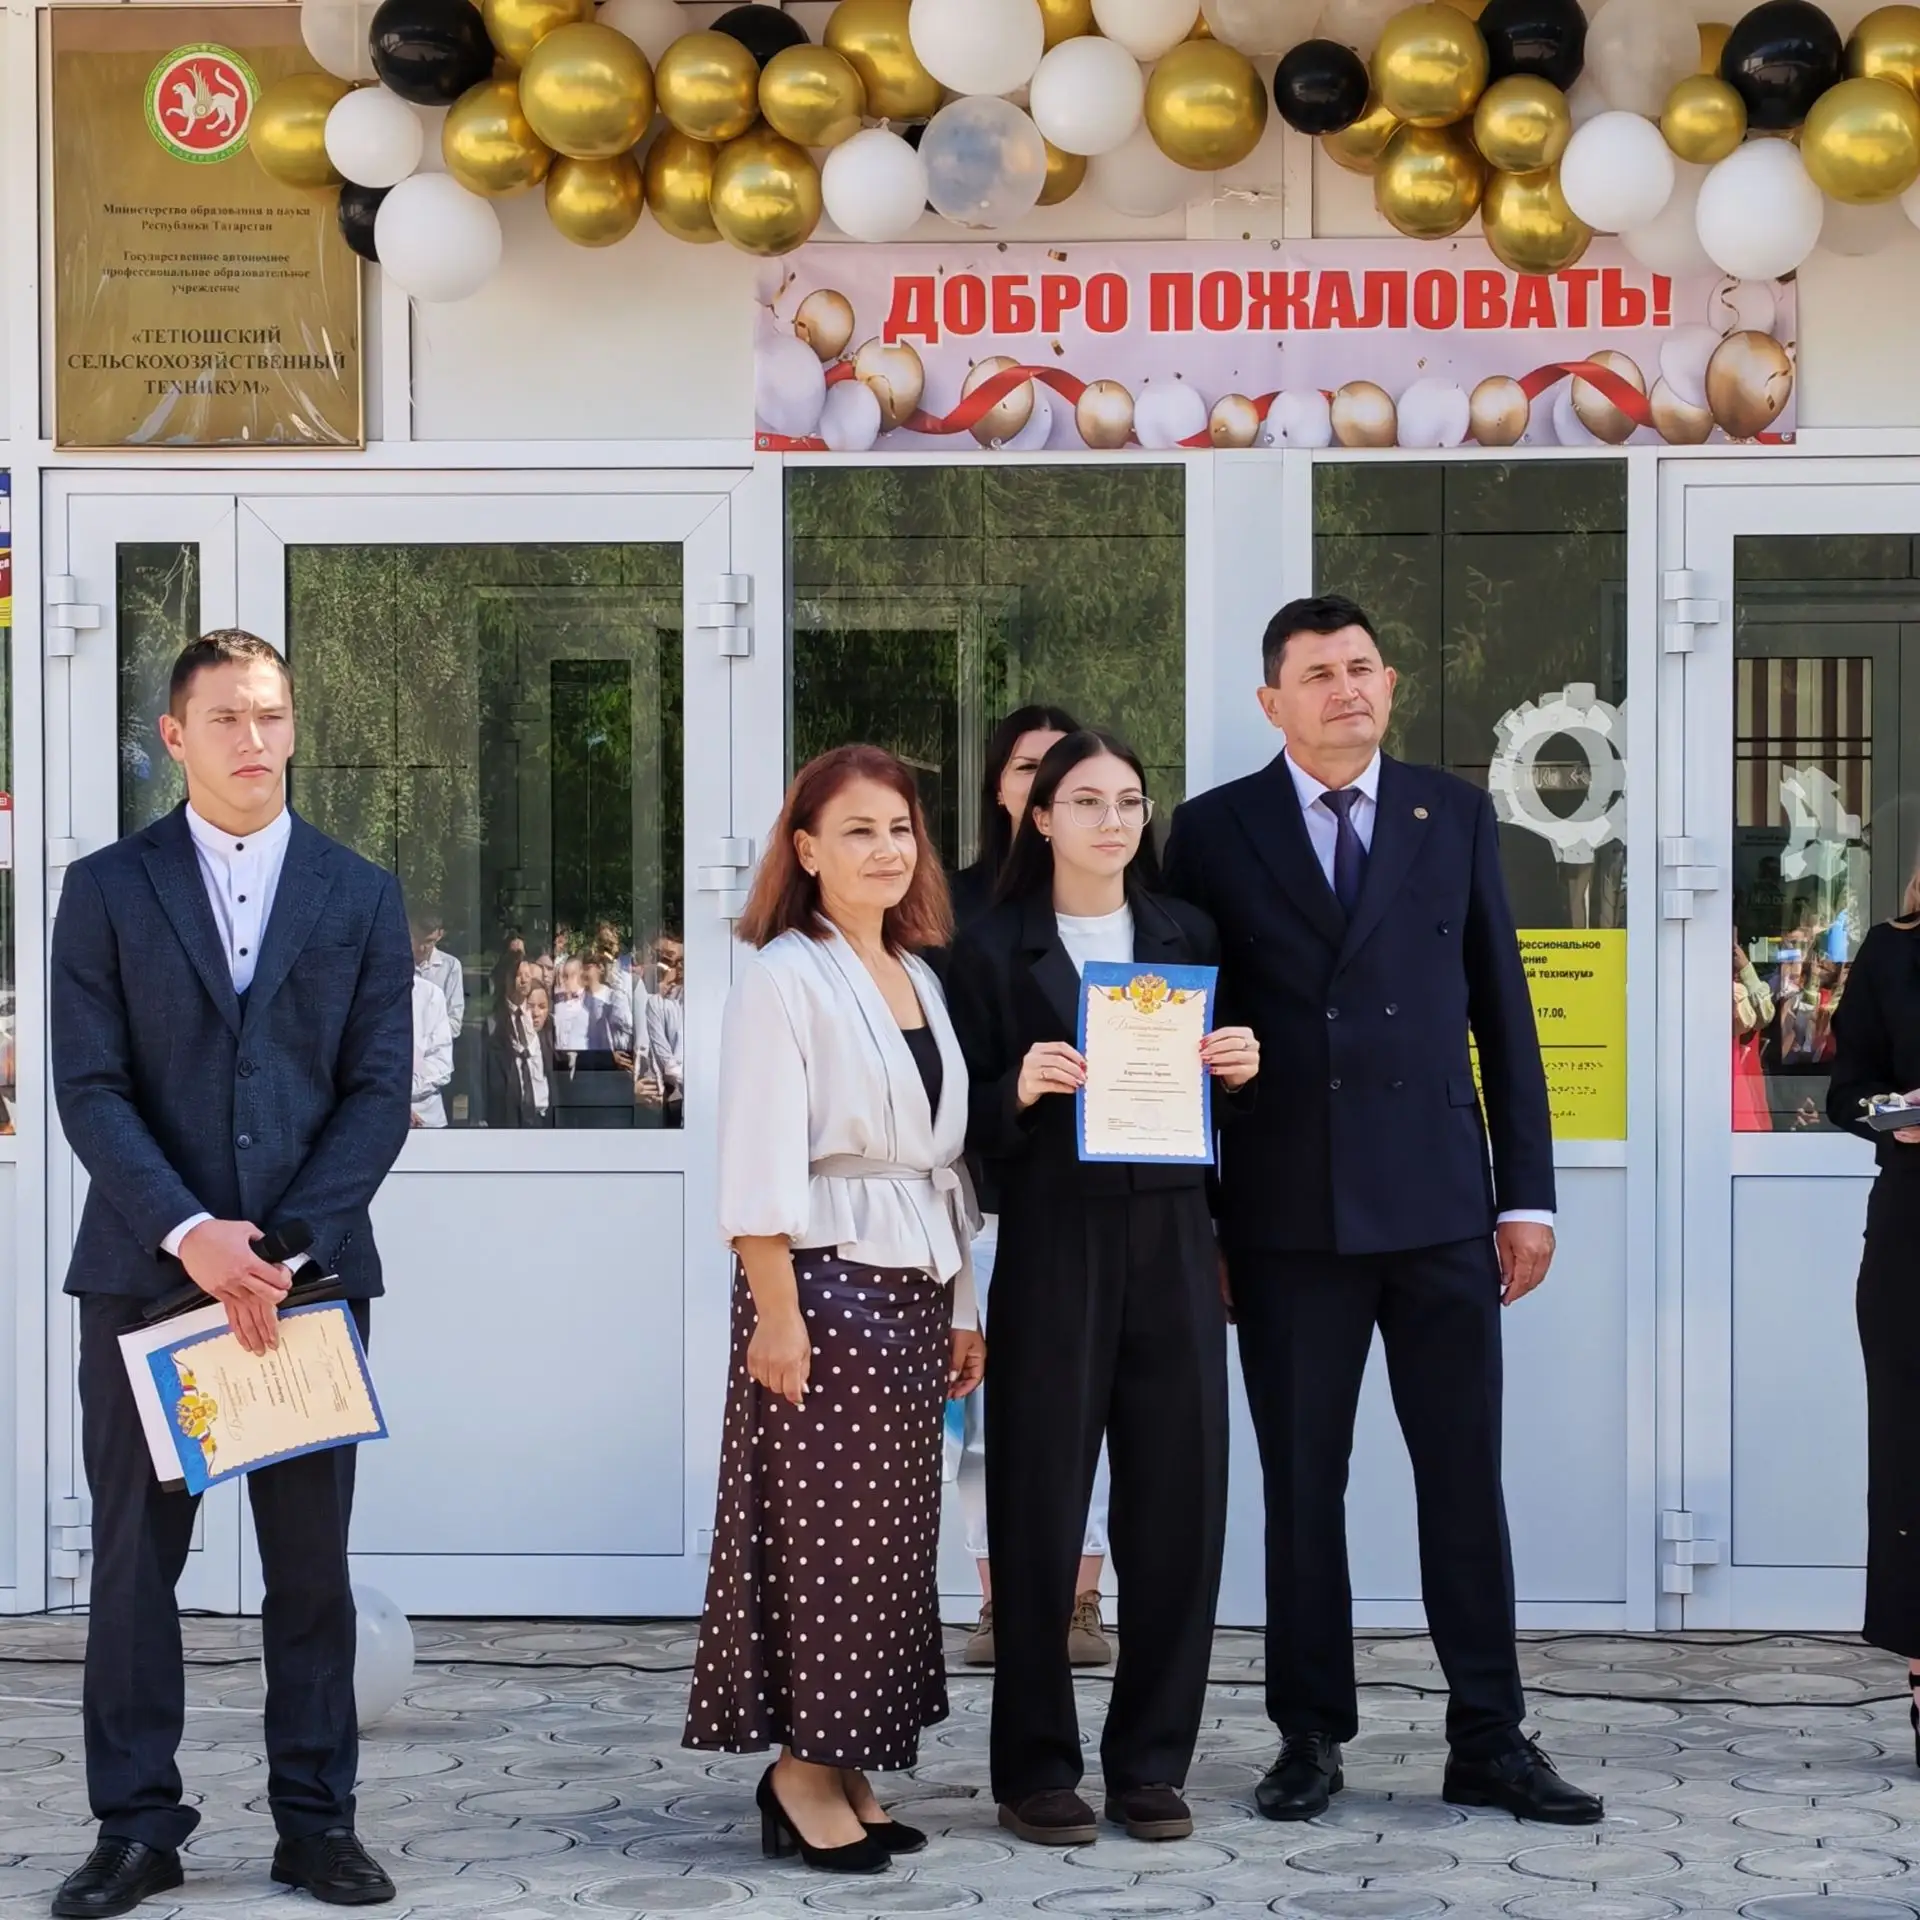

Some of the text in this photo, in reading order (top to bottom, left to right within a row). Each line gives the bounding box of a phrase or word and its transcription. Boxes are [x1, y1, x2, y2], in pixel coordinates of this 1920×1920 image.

[141, 221, 273, 234] Республики Татарстан
[123, 251, 290, 264] Государственное автономное
[171, 283, 241, 295] учреждение
[882, 267, 1672, 345] ДОБРО ПОЖАЛОВАТЬ!
[131, 324, 282, 344] «ТЕТЮШСКИЙ
[67, 351, 346, 369] СЕЛЬСКОХОЗЯЙСТВЕННЫЙ
[143, 379, 270, 395] ТЕХНИКУМ»
[1539, 969, 1594, 981] техникум»
[1537, 1007, 1567, 1019] 17.00,
